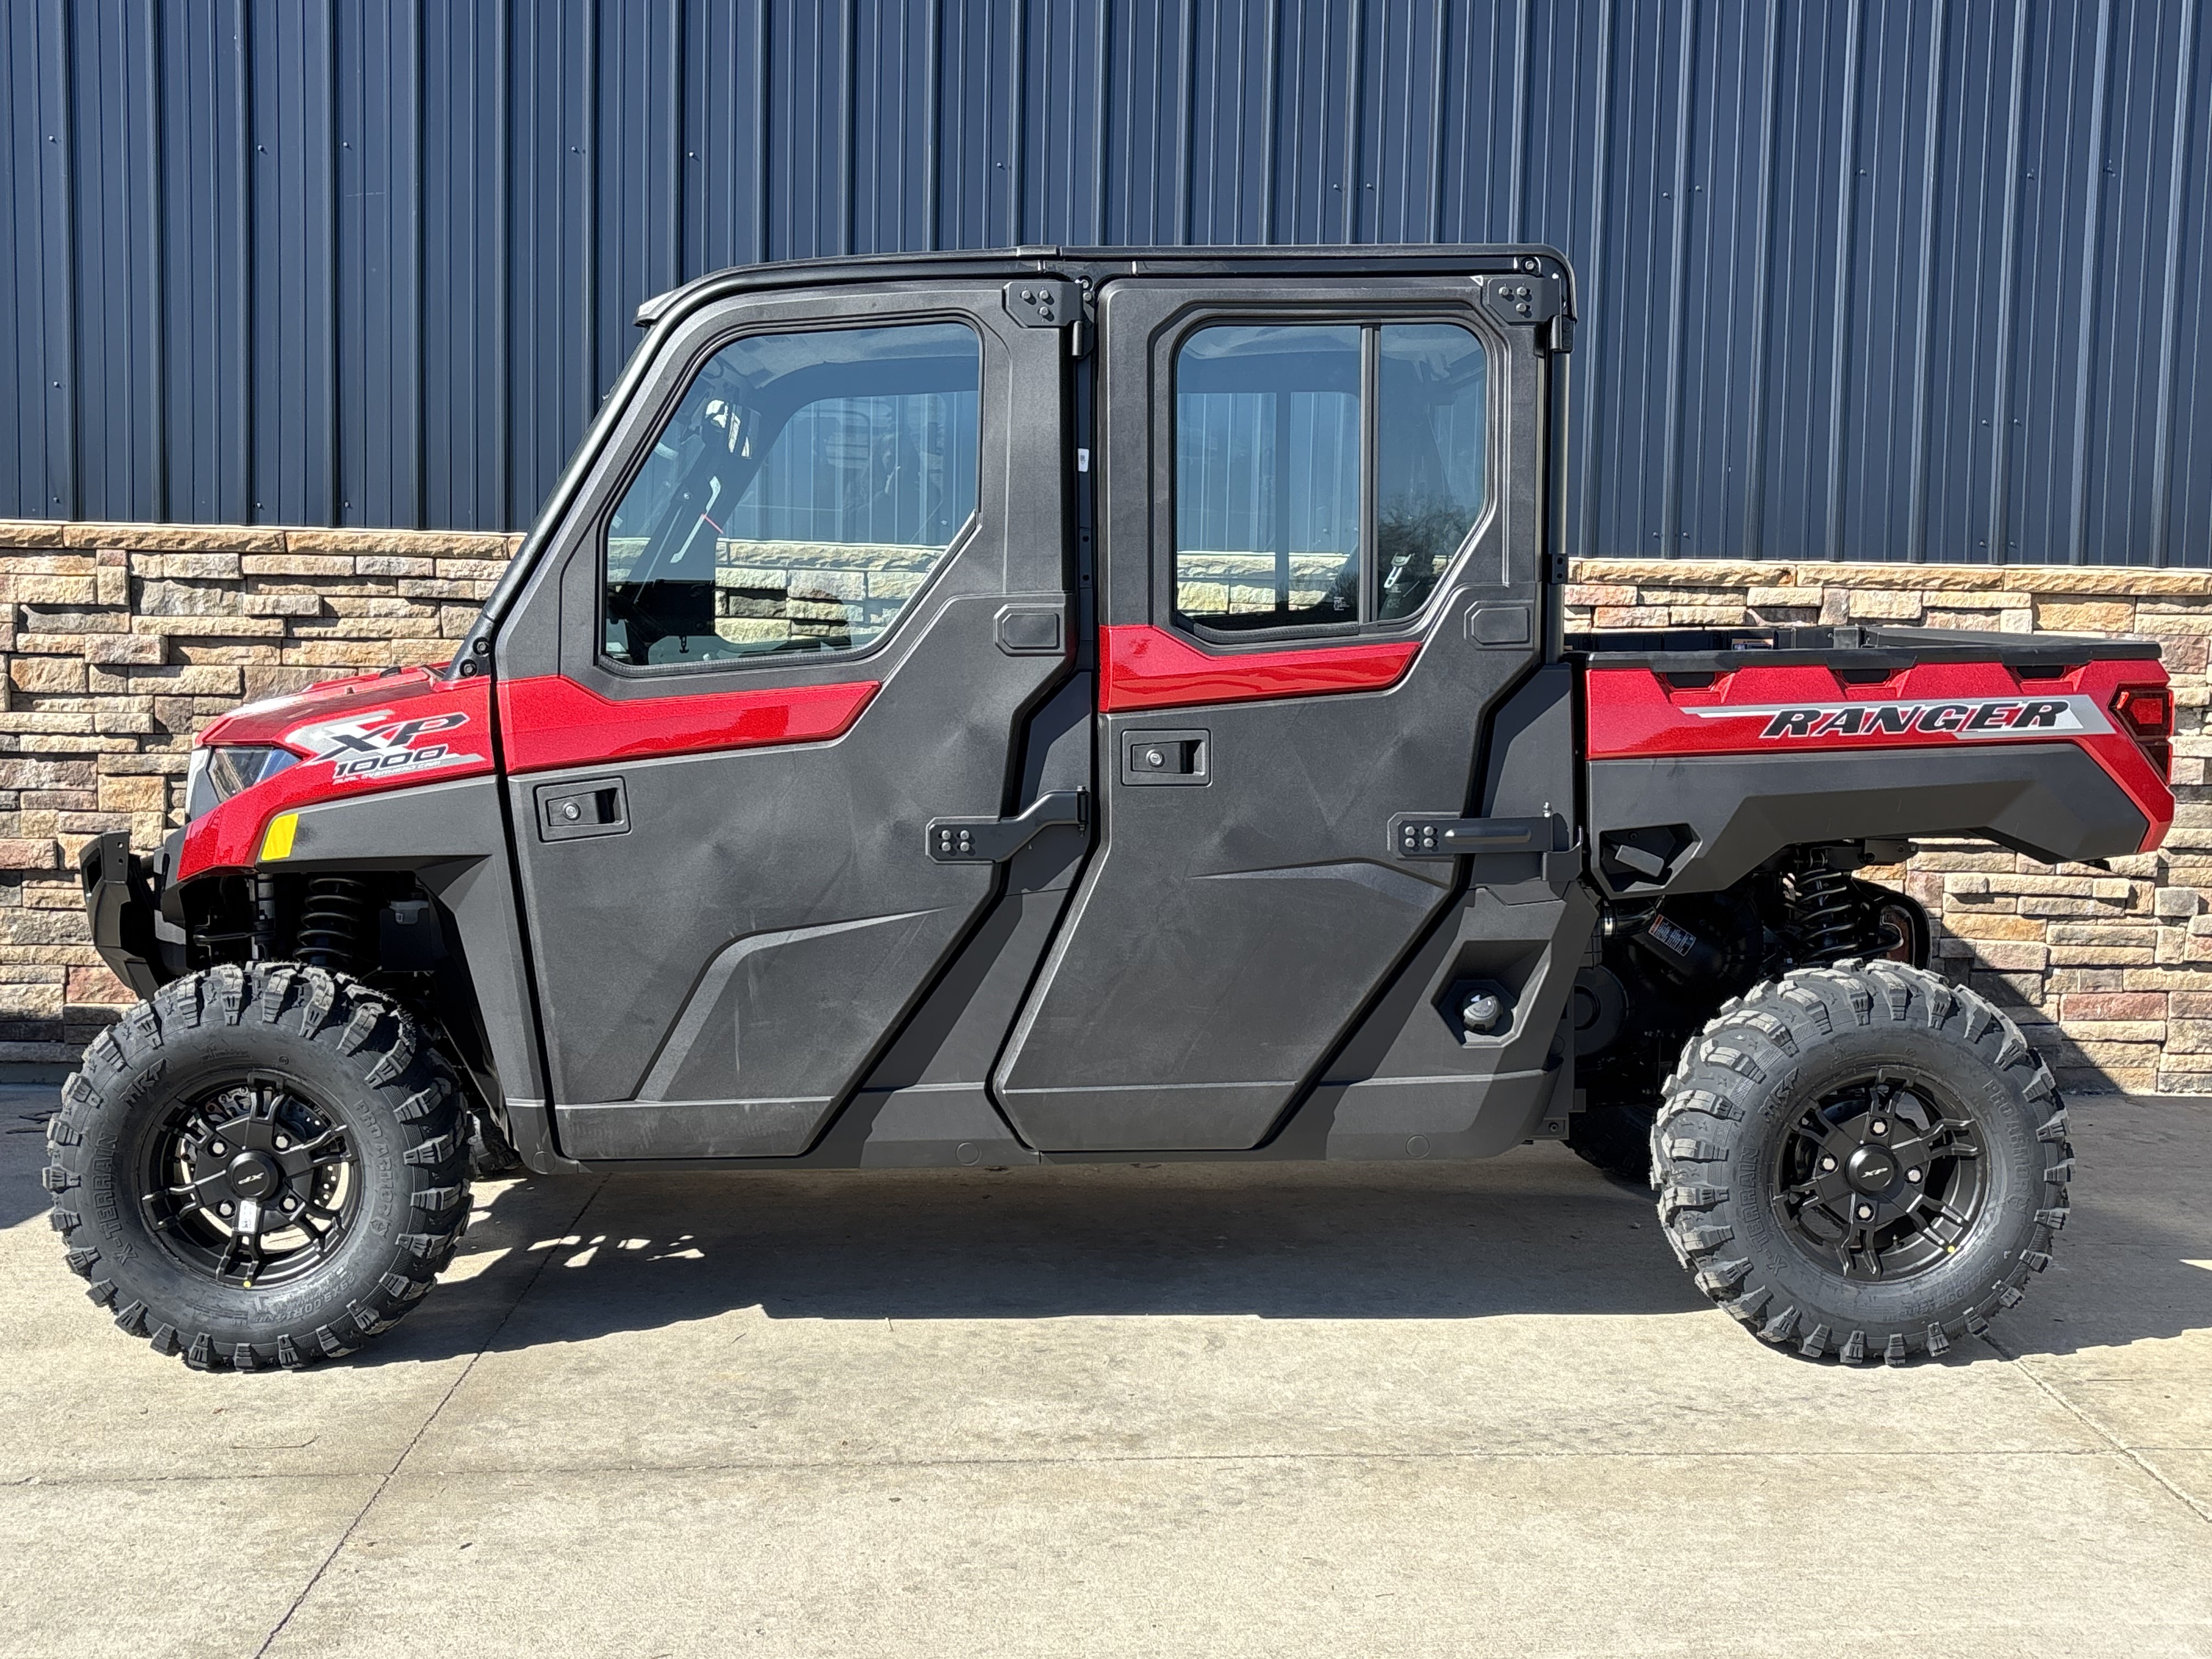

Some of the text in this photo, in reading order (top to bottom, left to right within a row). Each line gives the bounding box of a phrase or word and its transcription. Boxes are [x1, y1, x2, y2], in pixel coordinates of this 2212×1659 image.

[308, 712, 470, 762] XP
[1760, 701, 2070, 738] RANGER
[332, 760, 441, 785] DUAL OVERHEAD CAM
[334, 744, 448, 778] 1000
[119, 1057, 166, 1109] MRF
[354, 1099, 382, 1139] PRO
[1982, 1080, 2030, 1192] PRO ARMOR
[238, 1172, 264, 1185] XP
[1861, 1167, 1888, 1178] XP
[92, 1133, 138, 1266] X-TERRAIN
[1738, 1146, 1788, 1277] X-TERRAIN
